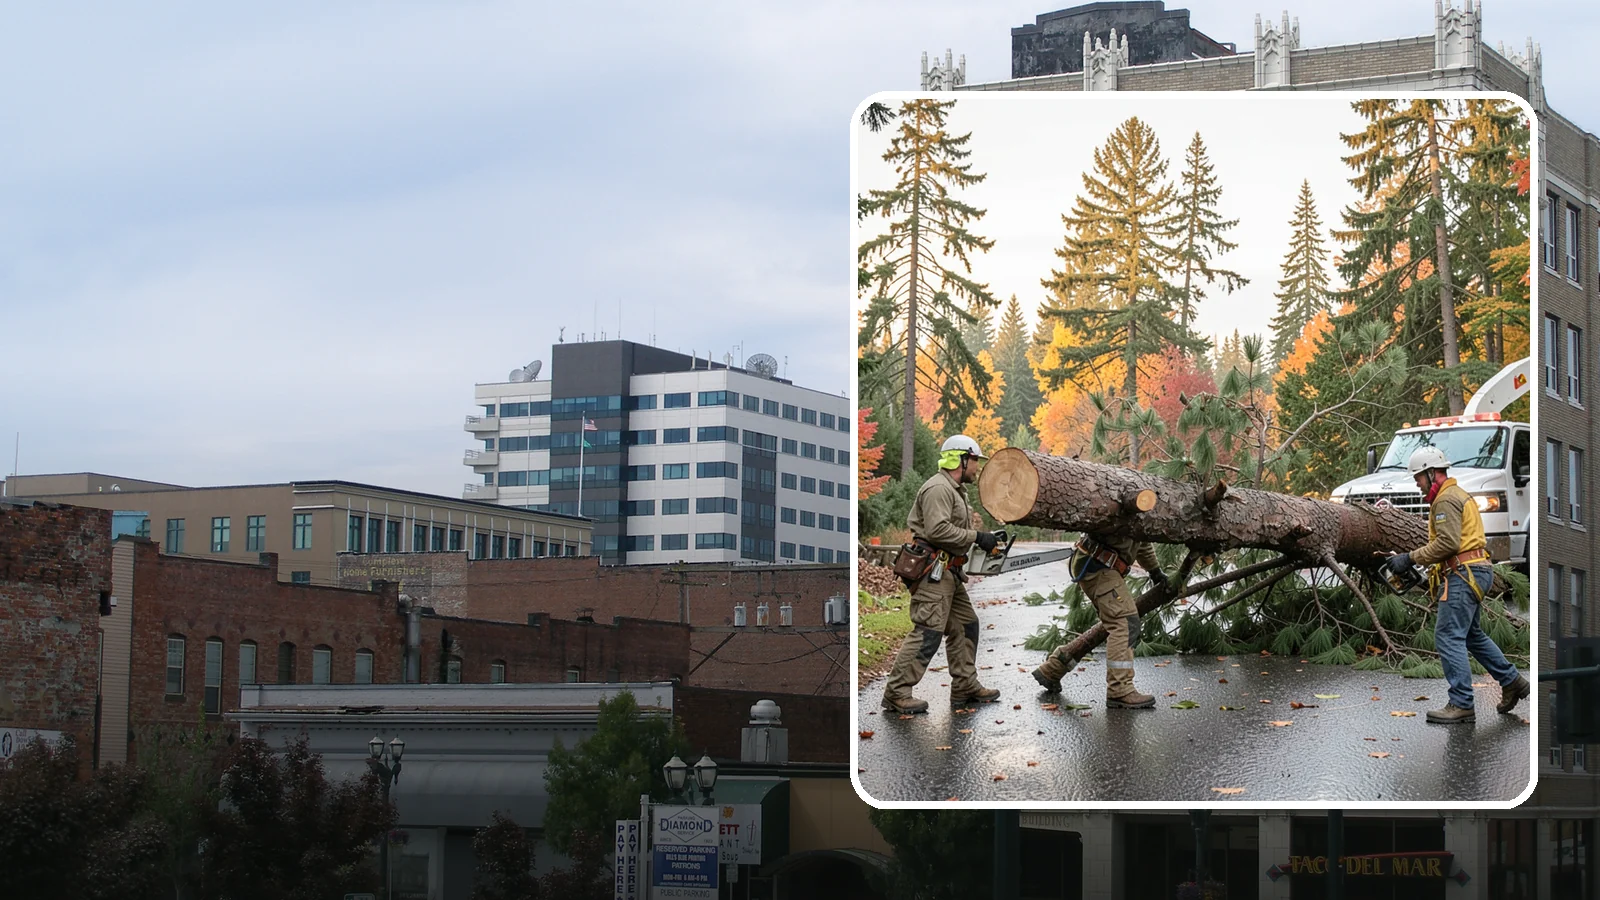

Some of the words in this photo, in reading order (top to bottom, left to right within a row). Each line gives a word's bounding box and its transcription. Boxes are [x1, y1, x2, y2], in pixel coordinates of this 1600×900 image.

[370, 566, 426, 576] Furnishers
[660, 818, 713, 832] DIAMOND
[1022, 815, 1070, 828] BUILDING
[617, 825, 625, 852] PAY
[628, 824, 636, 852] PAY
[616, 856, 625, 893] HERE
[627, 856, 636, 893] HERE
[671, 862, 701, 870] PATRONS
[1347, 857, 1385, 876] DEL
[1392, 857, 1442, 877] MAR
[661, 889, 682, 897] PUBLIC
[684, 889, 710, 898] PARKING
